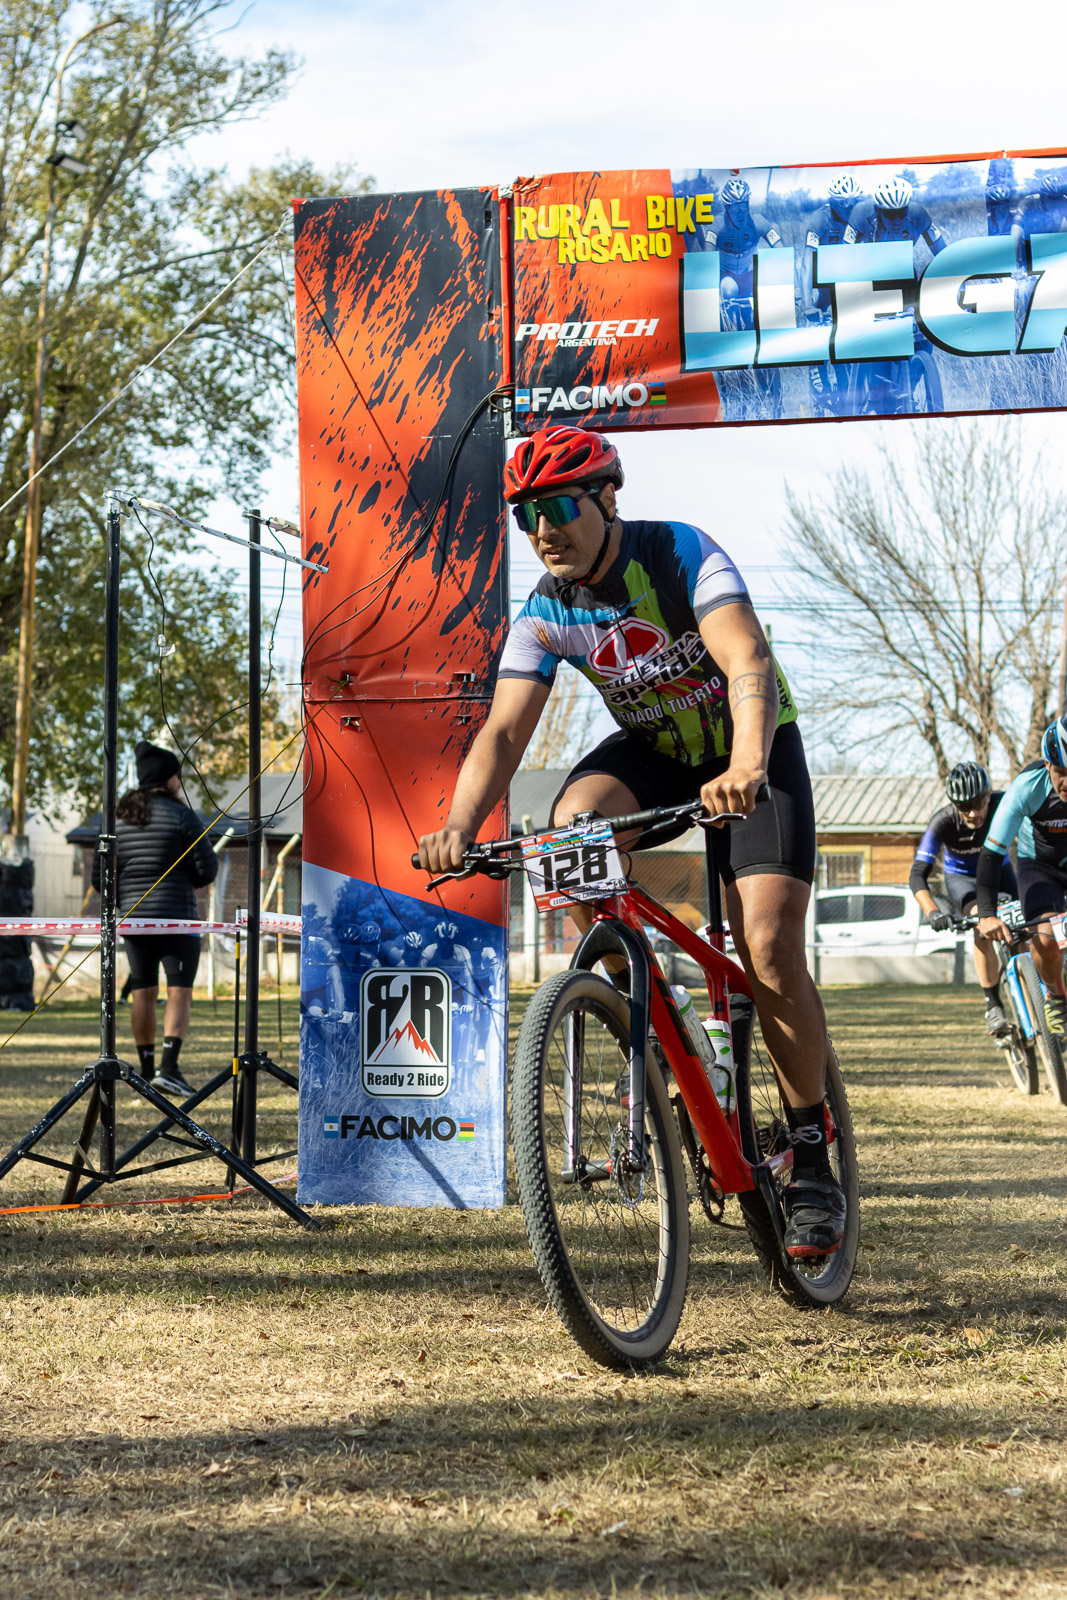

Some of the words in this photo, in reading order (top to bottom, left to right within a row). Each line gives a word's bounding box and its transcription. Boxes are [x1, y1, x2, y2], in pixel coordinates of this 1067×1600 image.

[514, 198, 630, 241] RURAL
[646, 193, 714, 235] BIKE
[558, 232, 672, 264] ROSARIO
[515, 318, 660, 342] PROTECH
[556, 336, 618, 348] ARGENTINA
[532, 382, 648, 412] FACIMO
[606, 638, 706, 704] aprida
[667, 676, 722, 713] TUERTO
[539, 847, 608, 892] 128
[367, 1072, 406, 1087] Ready
[407, 1072, 414, 1086] 2
[418, 1072, 444, 1086] Ride
[341, 1115, 457, 1141] FACIMO
